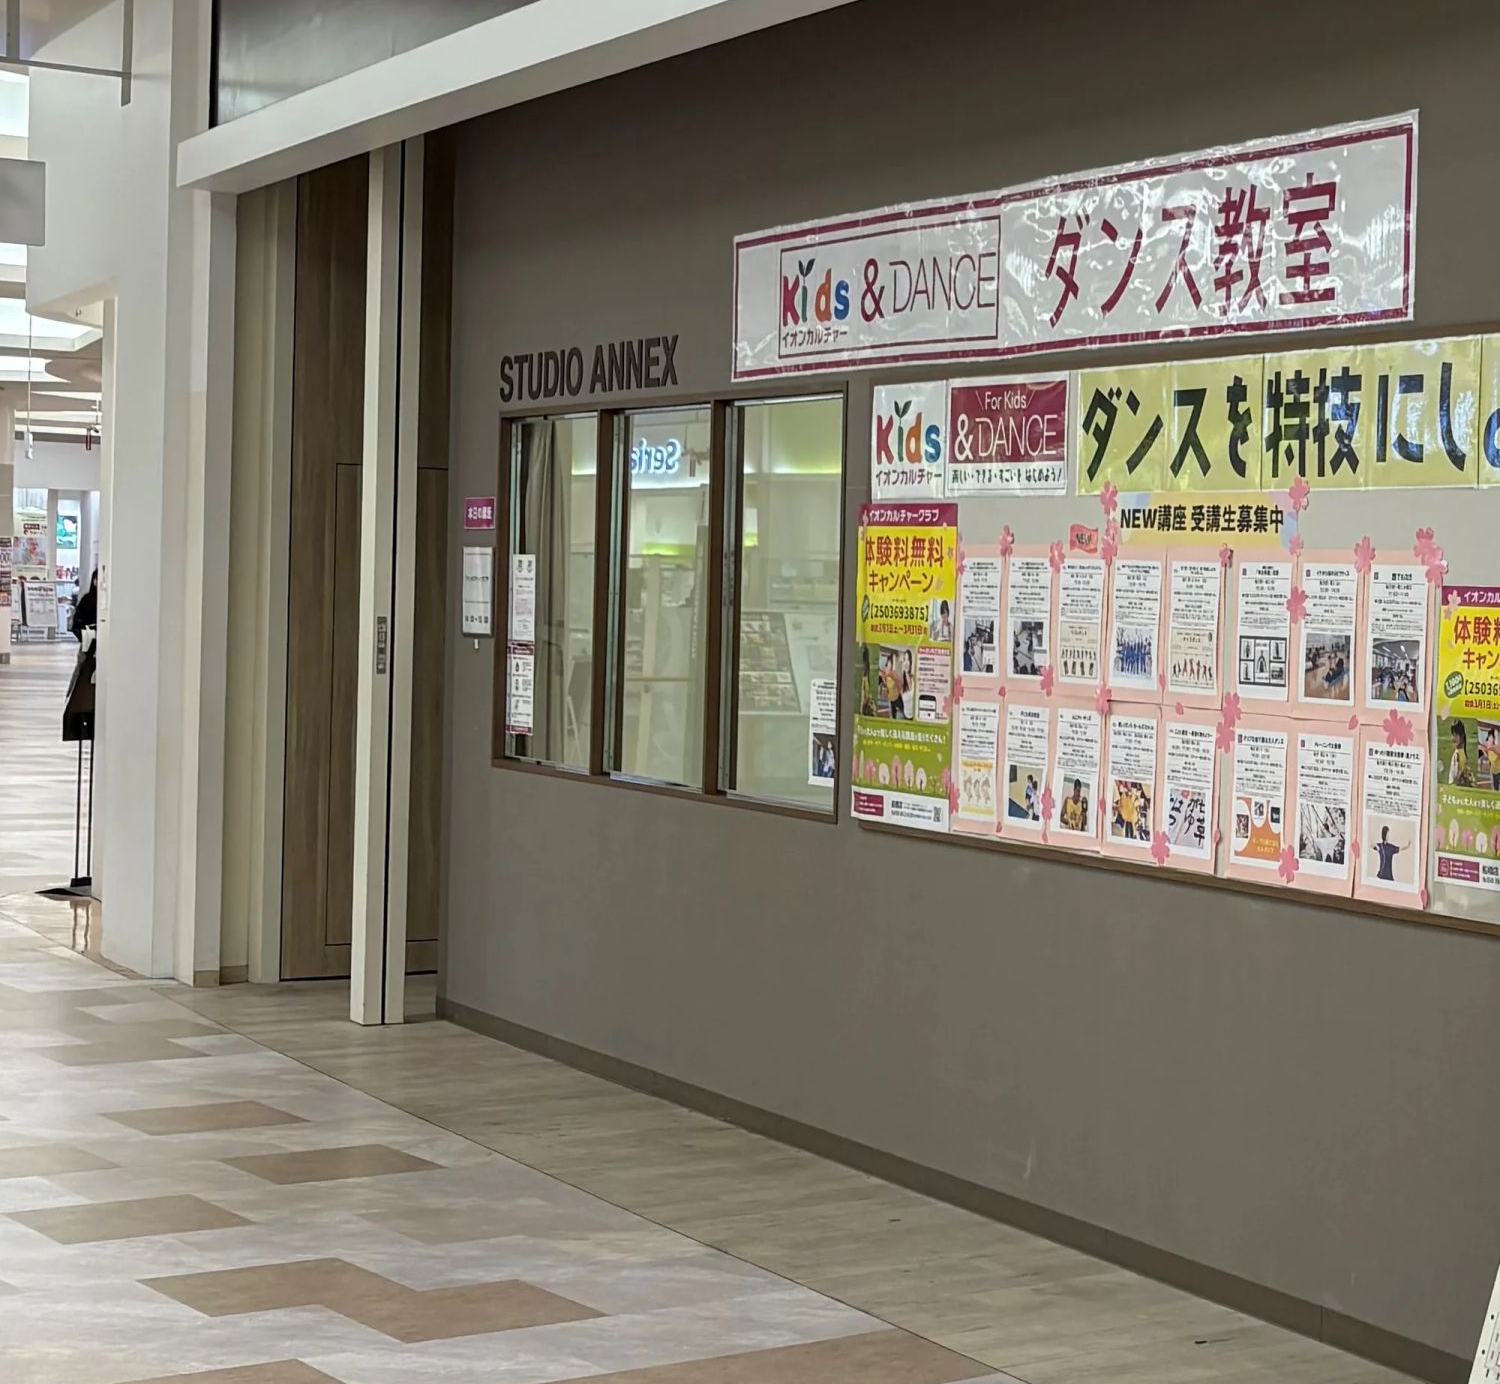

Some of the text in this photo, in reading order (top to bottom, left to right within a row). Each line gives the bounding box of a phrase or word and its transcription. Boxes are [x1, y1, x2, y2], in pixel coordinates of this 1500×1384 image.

[1043, 171, 1338, 329] ダンス教室
[782, 252, 997, 327] Kids & DANCE
[782, 327, 848, 348] イオンカルチャー
[499, 334, 680, 403] STUDIO ANNEX
[984, 390, 1028, 411] For Kids
[876, 400, 941, 465] Kids
[954, 413, 1058, 462] & DANCE
[876, 469, 942, 487] イオンカルチャー
[1190, 505, 1284, 534] 受講生募集中
[869, 570, 934, 593] キャンペーン
